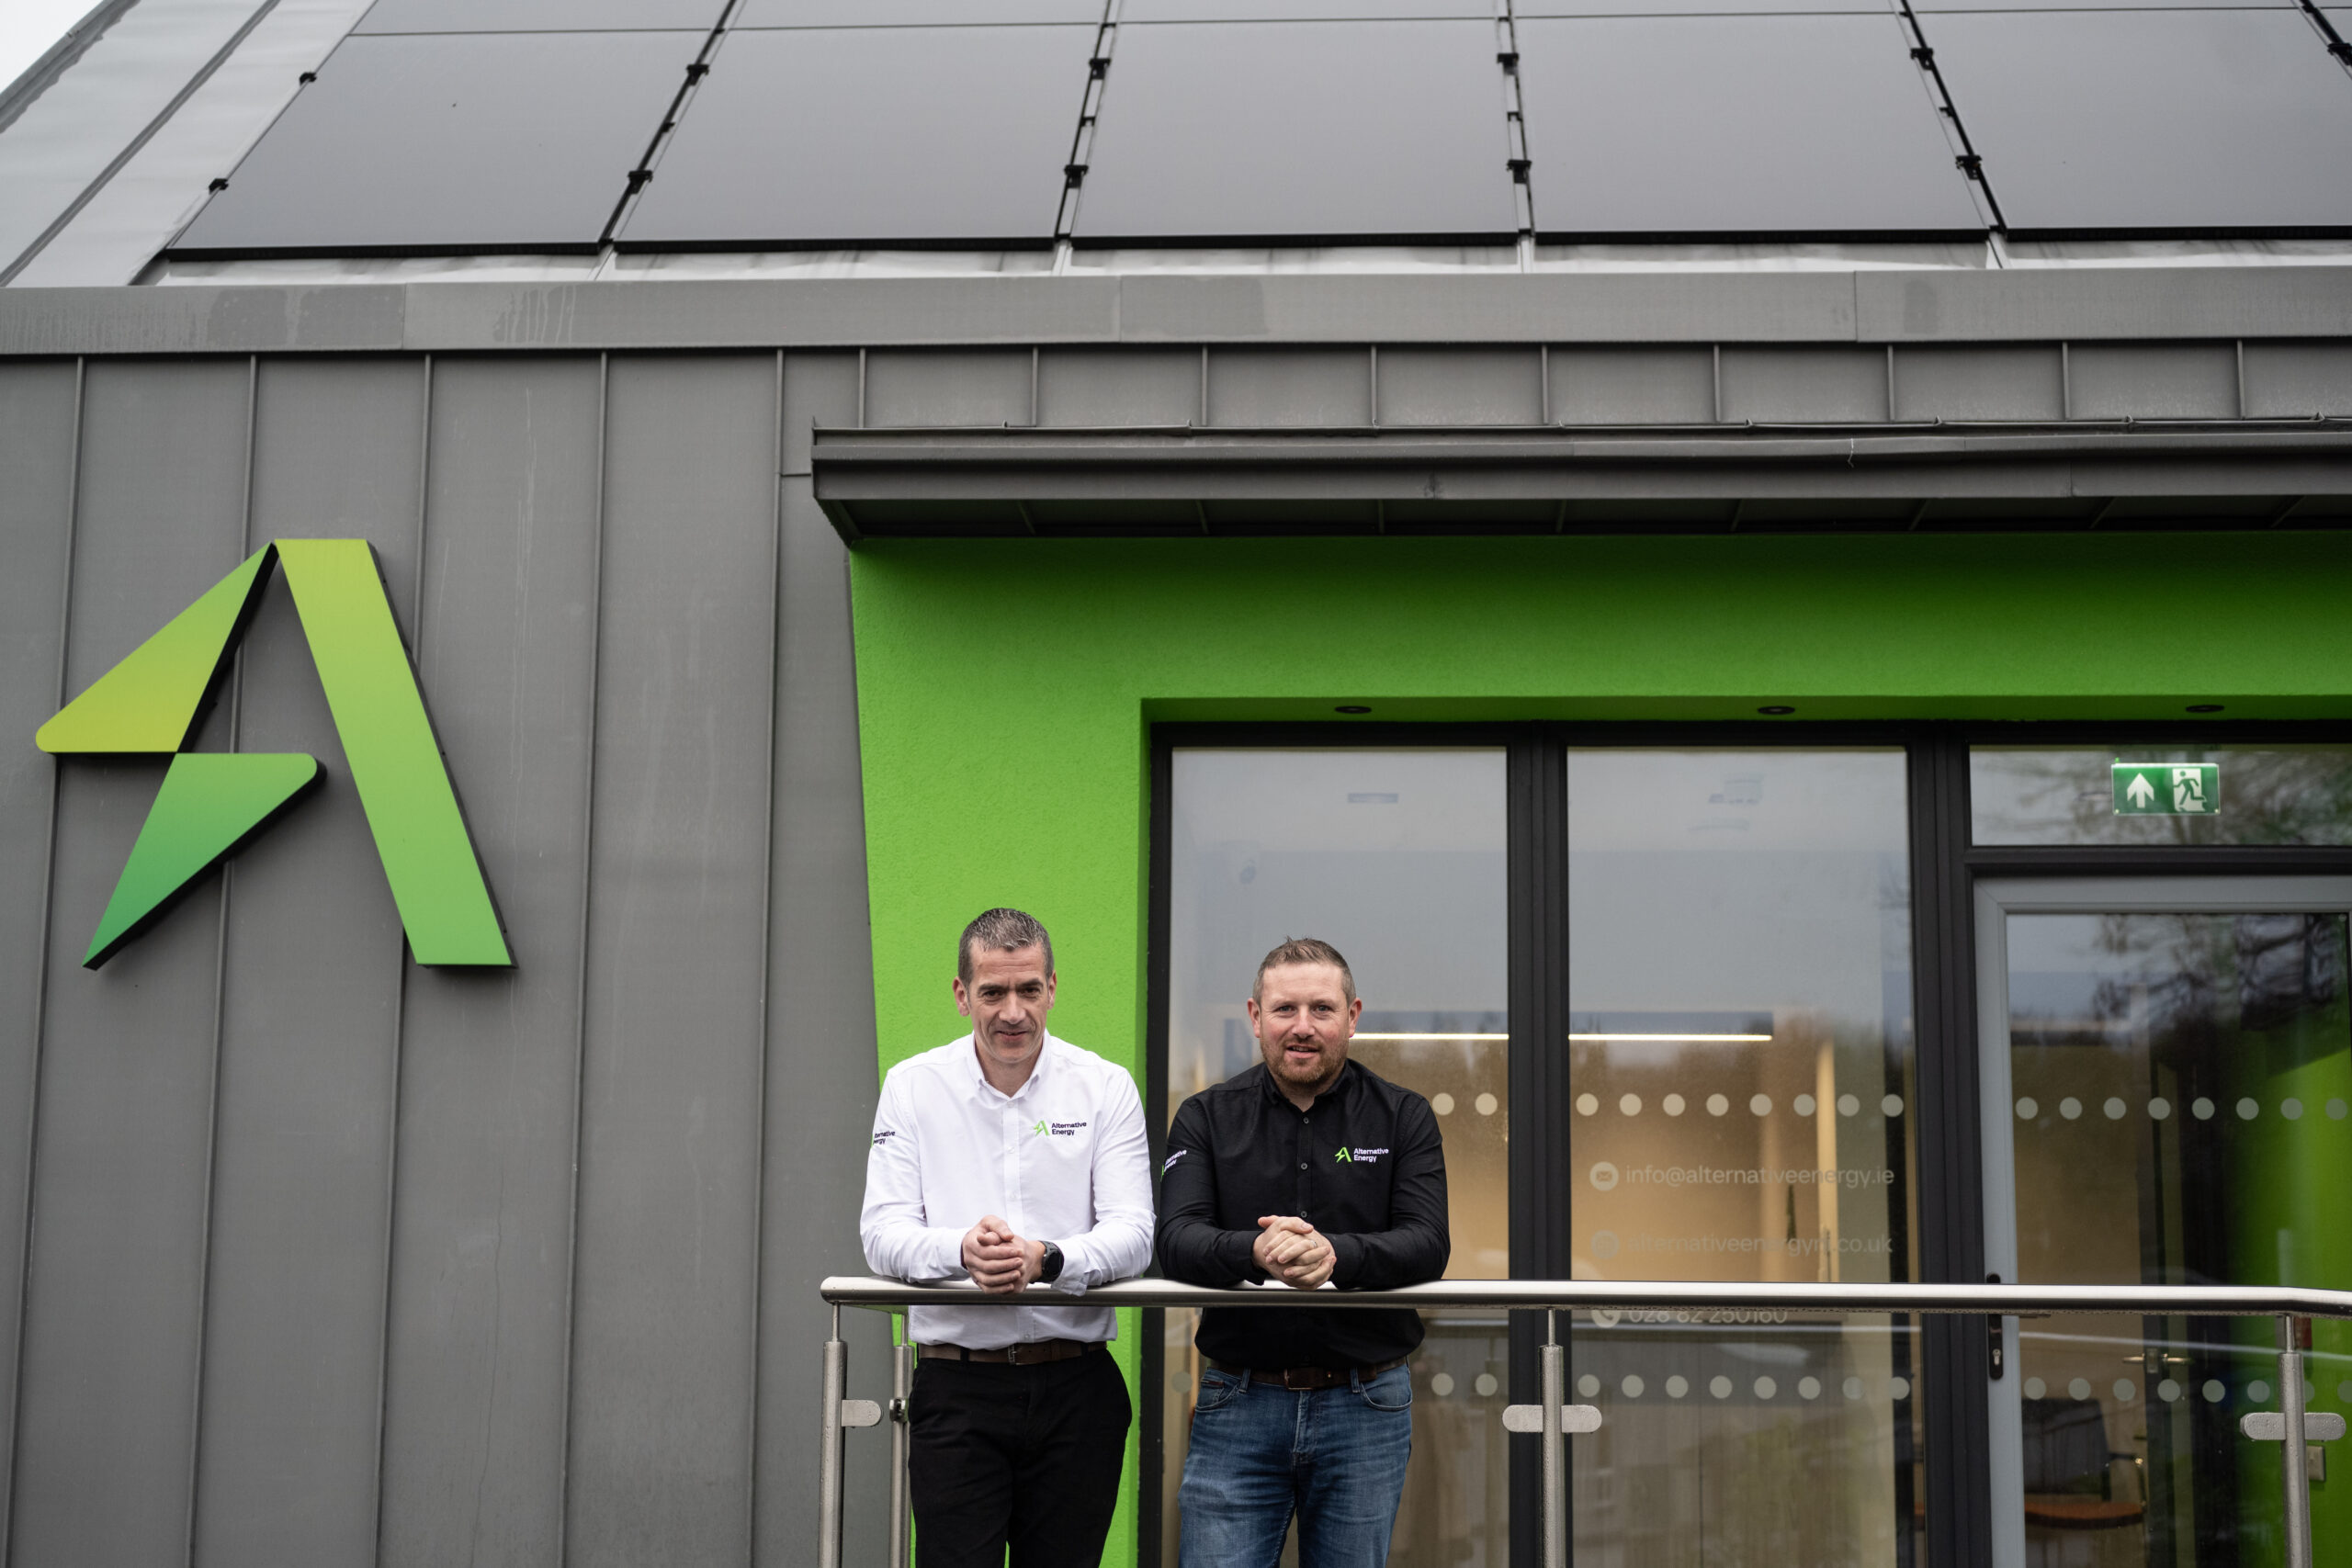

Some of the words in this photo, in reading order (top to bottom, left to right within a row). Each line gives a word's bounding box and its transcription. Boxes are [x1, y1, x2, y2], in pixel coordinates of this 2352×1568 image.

[1051, 1121, 1087, 1129] Alternative
[1051, 1128, 1075, 1136] Energy
[1353, 1147, 1389, 1156] Alternative
[1353, 1154, 1377, 1163] Energy
[1625, 1164, 1895, 1190] info@alternativeenergy.ie
